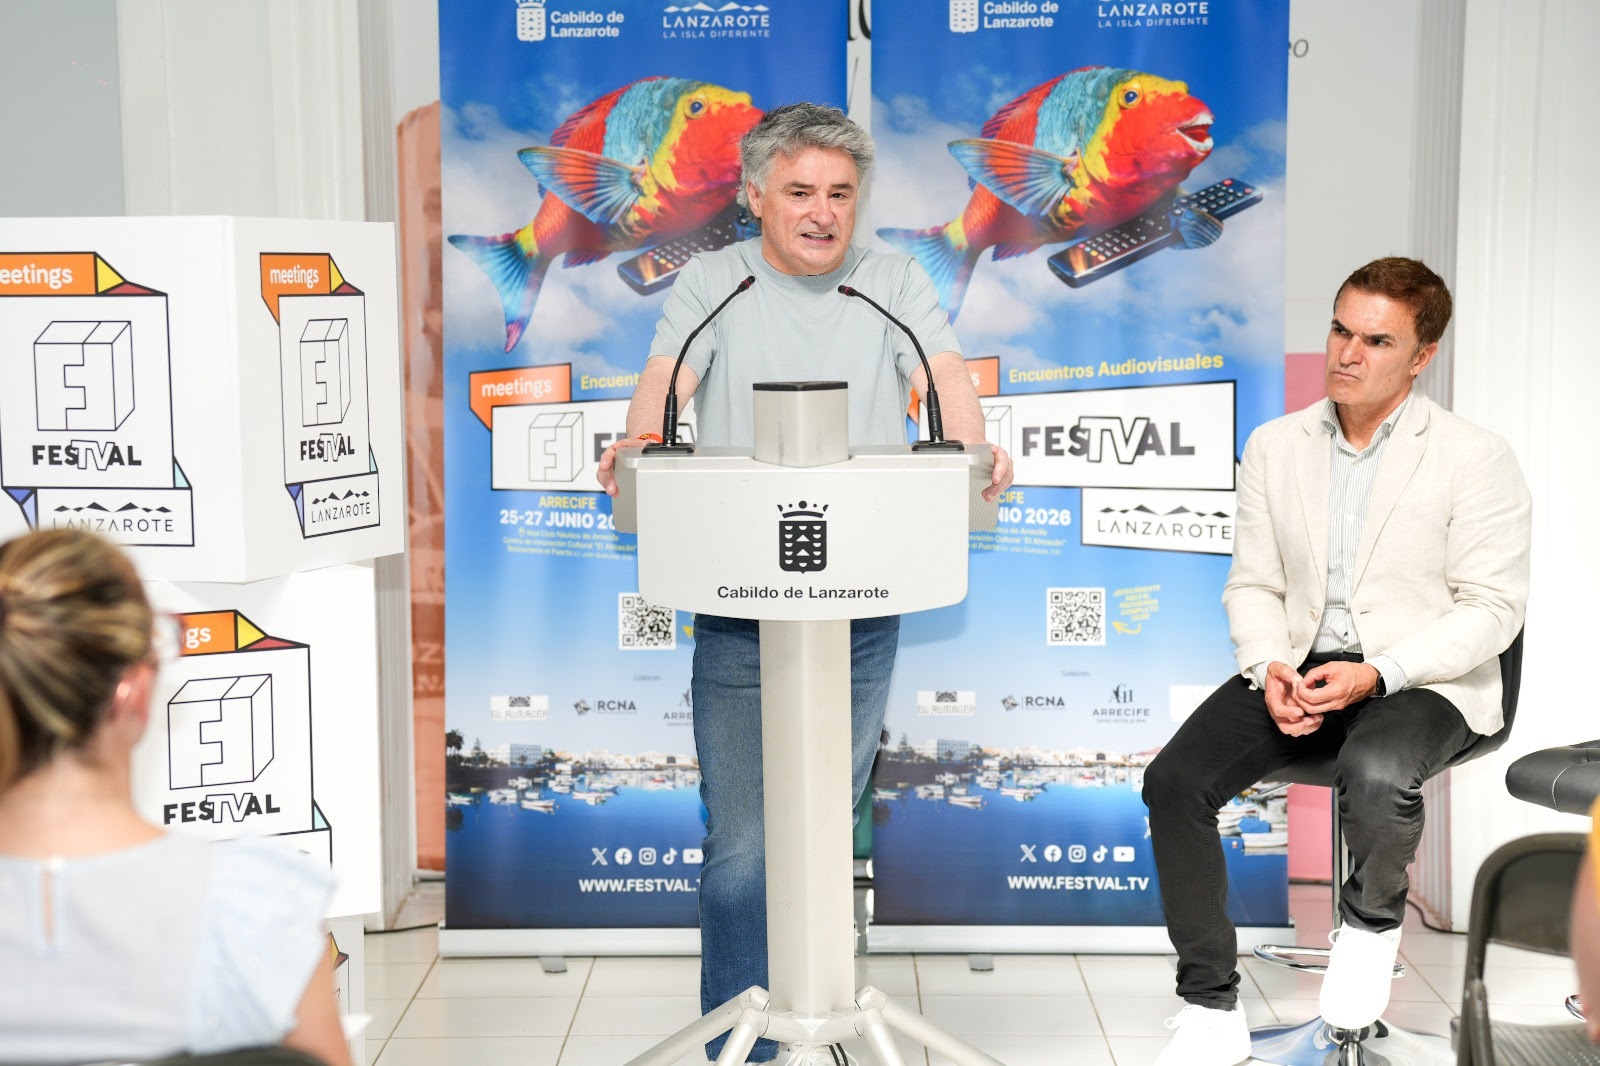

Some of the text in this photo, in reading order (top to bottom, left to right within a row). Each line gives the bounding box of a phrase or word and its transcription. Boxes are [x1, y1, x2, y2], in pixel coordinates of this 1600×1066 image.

[984, 1, 1059, 15] Cabildo de
[1098, 2, 1208, 17] LANZAROTE
[551, 11, 624, 24] Cabildo de
[663, 15, 769, 28] LANZAROTE
[984, 15, 1054, 28] Lanzarote
[1098, 17, 1208, 28] LA ISLA DIFERENTE
[551, 25, 619, 37] Lanzarote
[663, 31, 676, 39] LA
[710, 30, 770, 38] DIFERENTE
[0, 263, 73, 290] eetings
[269, 264, 320, 289] meetings
[1009, 353, 1224, 384] Encuentros Audiovisuales
[482, 376, 552, 398] meetings
[581, 374, 640, 390] Encuent
[1022, 415, 1196, 465] FESTVAL
[300, 433, 355, 462] FESTVAL
[32, 439, 142, 471] FESTVAL
[539, 496, 596, 510] ARRECIFE
[998, 491, 1024, 504] CIFE
[311, 502, 371, 523] LANZAROTE
[500, 509, 543, 526] 25-27
[545, 511, 594, 529] JUNIO
[1025, 507, 1072, 526] 2026
[1097, 519, 1233, 540] LANZAROTE
[717, 586, 889, 599] Cabildo de Lanzarote
[597, 700, 637, 711] RCNA
[1025, 696, 1065, 707] RCNA
[663, 712, 693, 720] ARRE
[1093, 708, 1150, 717] ARRECIFE
[163, 792, 280, 825] FESTVAL
[579, 879, 701, 892] WWW.FESTVAL.
[1007, 876, 1149, 890] WWW.FESTVAL.TV
